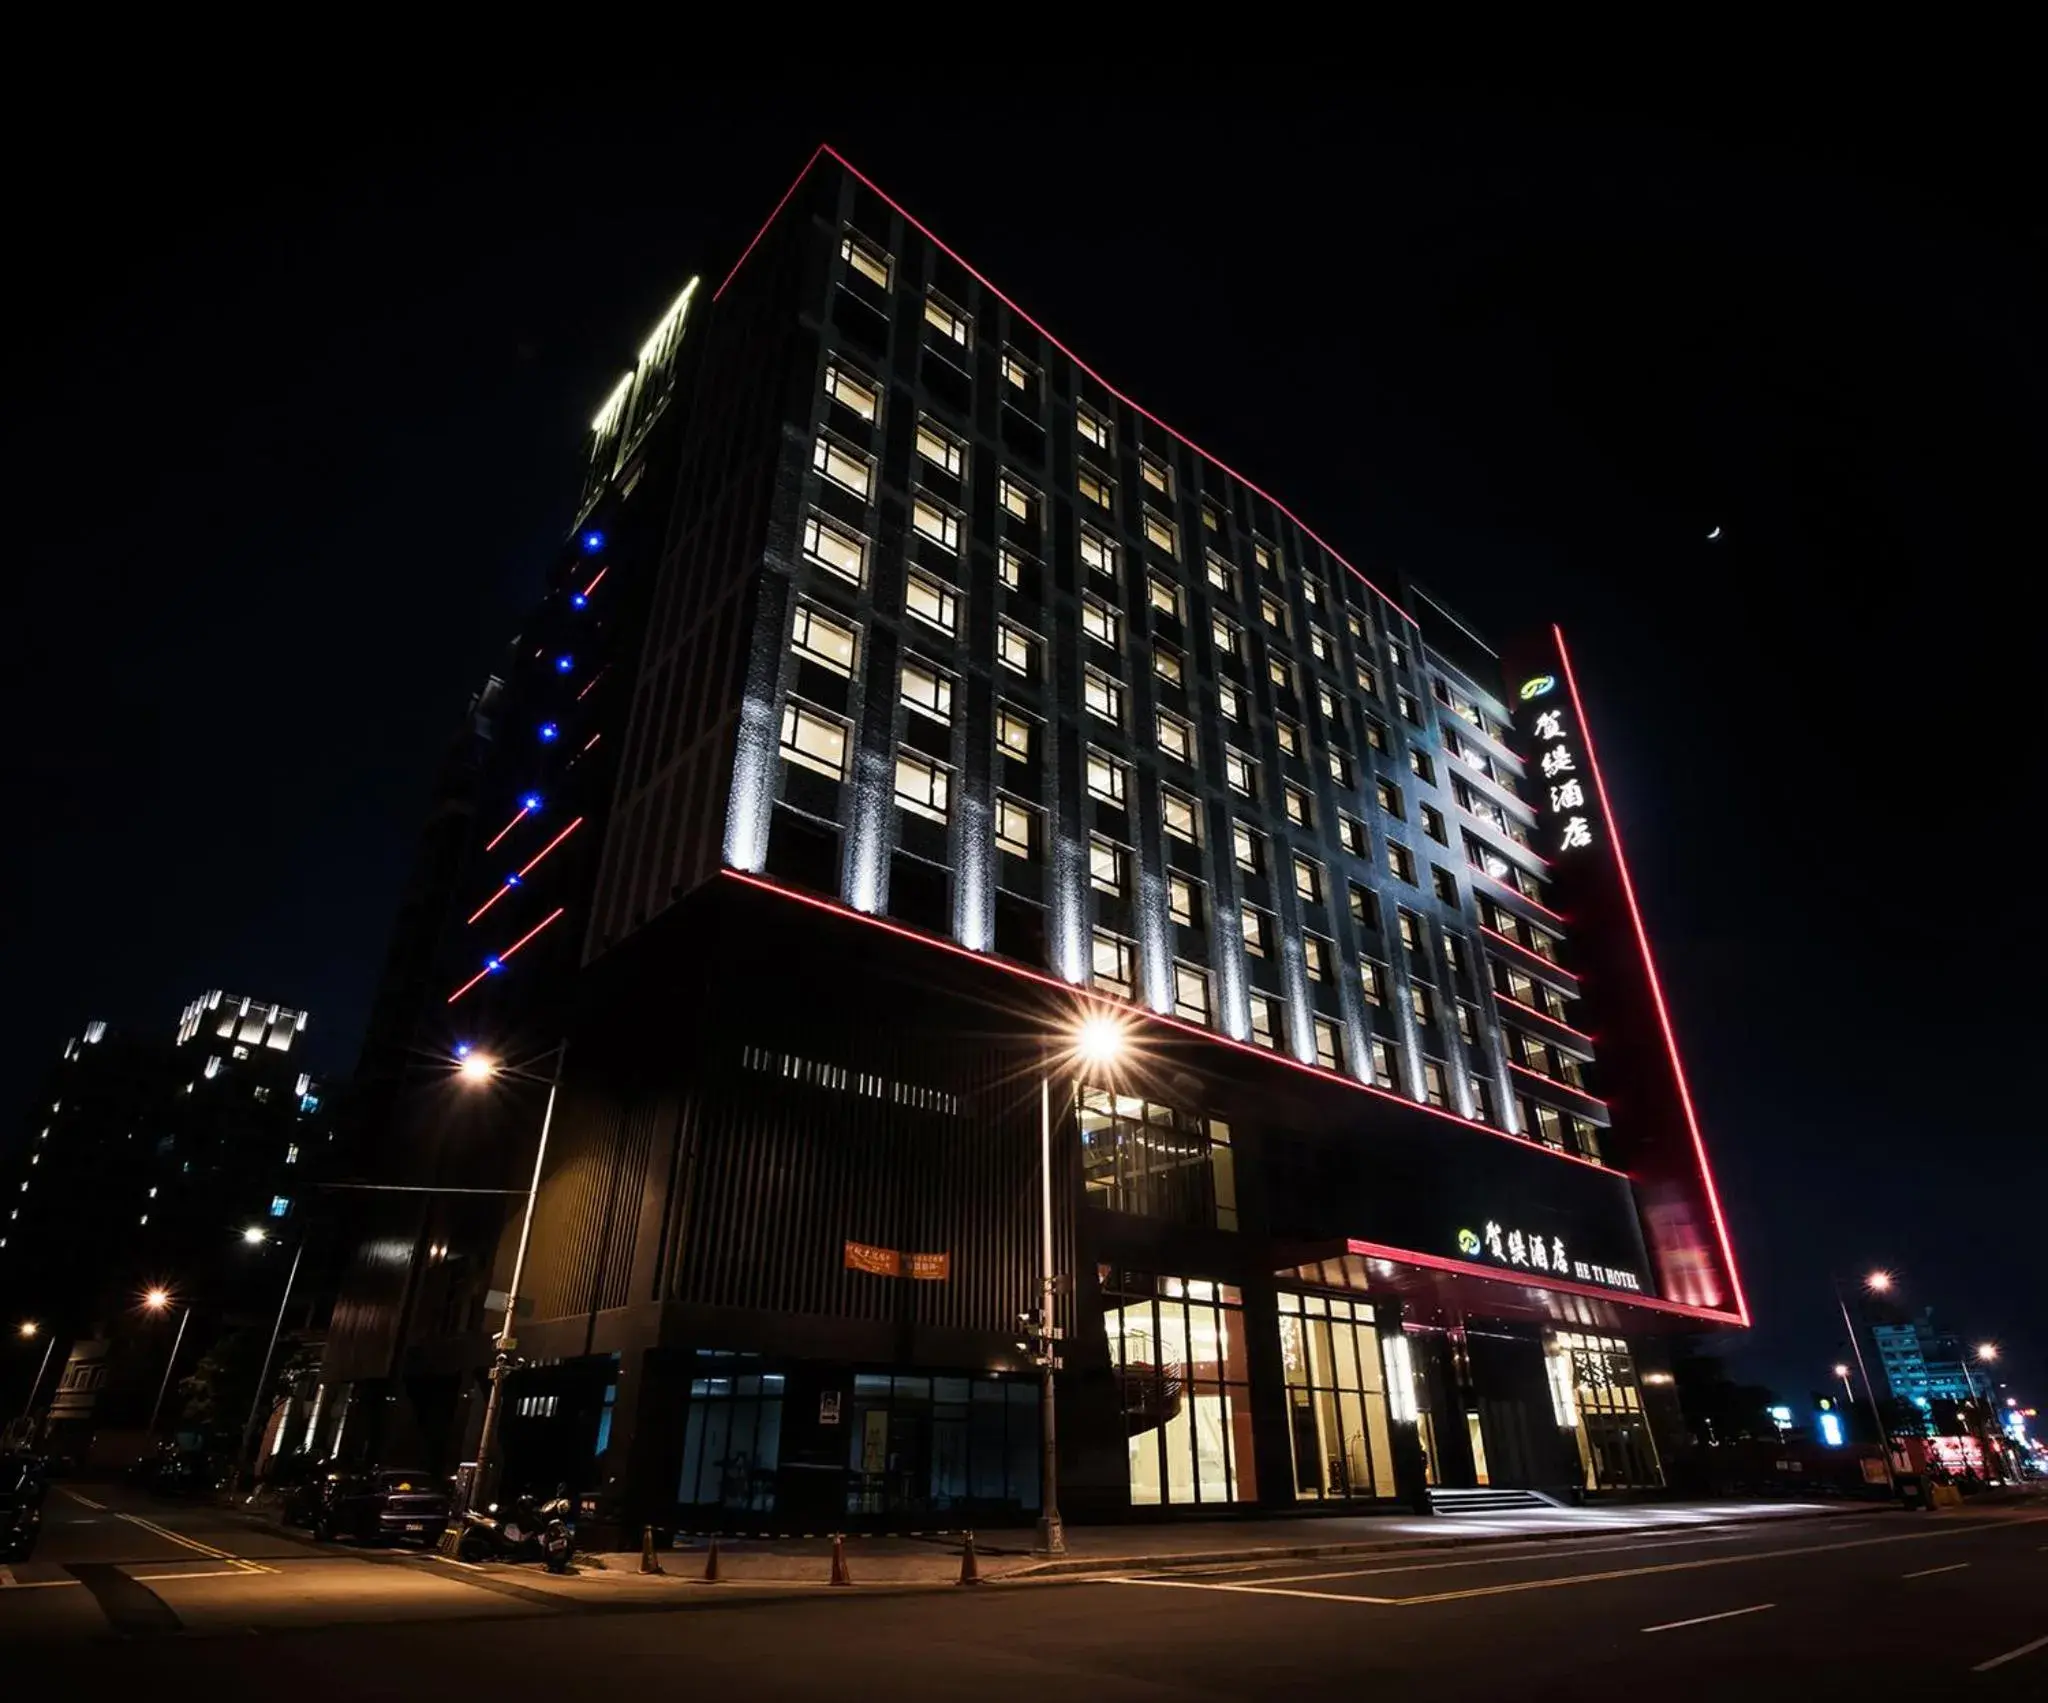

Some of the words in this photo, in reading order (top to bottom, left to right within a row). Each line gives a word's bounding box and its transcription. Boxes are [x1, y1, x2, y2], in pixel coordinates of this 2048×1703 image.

[1574, 1261, 1591, 1280] HE
[1591, 1265, 1605, 1283] TI
[1605, 1268, 1640, 1290] HOTEL
